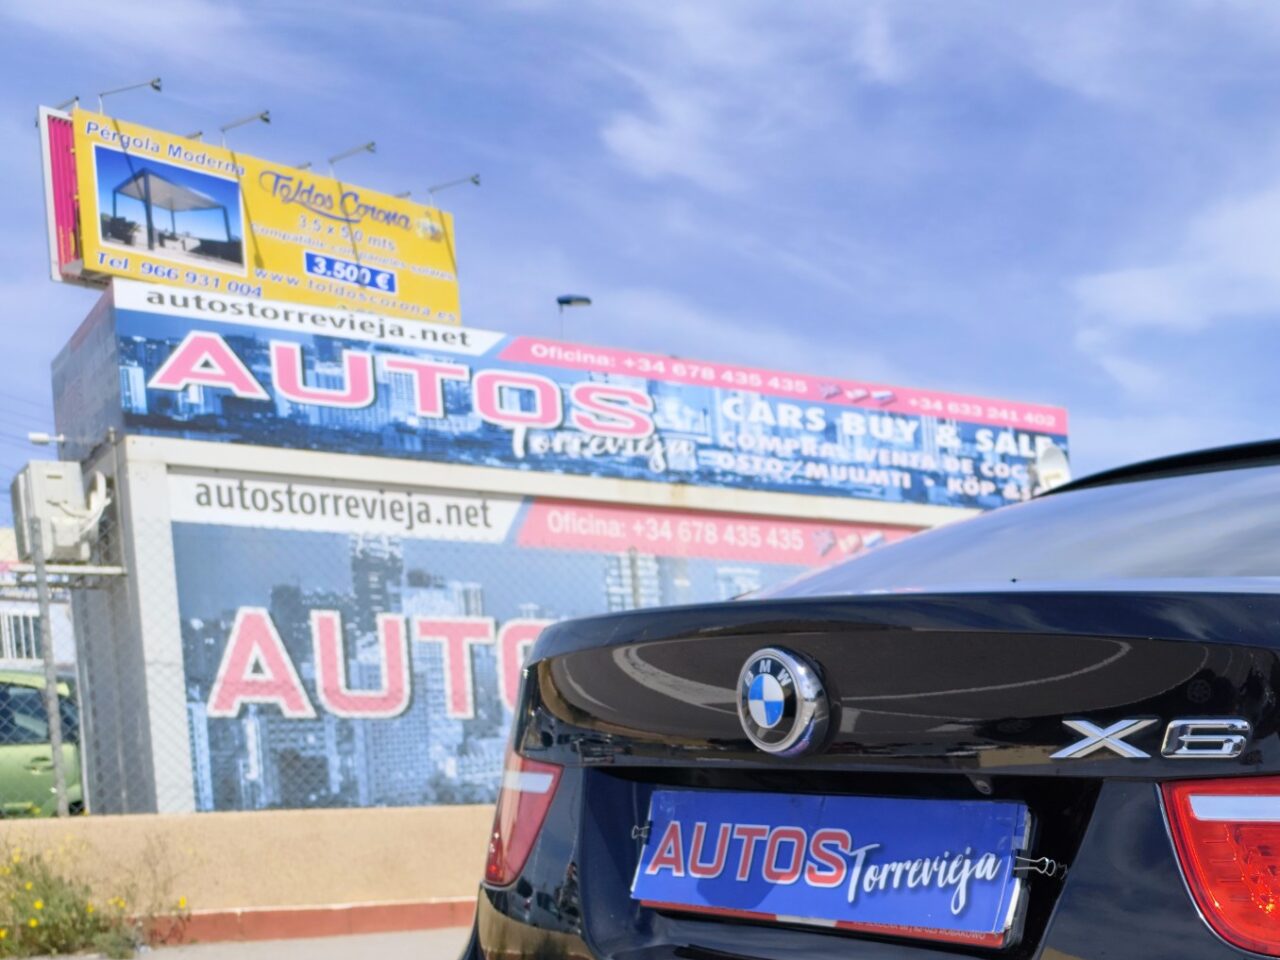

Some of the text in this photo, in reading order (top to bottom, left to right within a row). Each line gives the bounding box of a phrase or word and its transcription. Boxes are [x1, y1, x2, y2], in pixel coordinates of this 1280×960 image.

[86, 120, 245, 177] Pérgola Moderna
[258, 170, 412, 231] Toldos Corona
[141, 261, 179, 281] 966
[185, 270, 220, 289] 931
[227, 280, 263, 298] 004
[312, 255, 391, 291] 3.500 €
[147, 289, 472, 348] autostorrevieja.net
[147, 329, 654, 438] AUTOS
[530, 342, 808, 394] Oficina: +34 678 435 435
[722, 397, 827, 432] CARS
[840, 411, 919, 443] BUY
[935, 423, 961, 449] &
[909, 397, 944, 412] +34
[943, 455, 974, 476] DE
[196, 482, 492, 530] autostorrevieja.net
[547, 510, 804, 550] Oficina: +34 678 435 435
[745, 659, 792, 688] BMW
[1049, 718, 1251, 759] X6
[645, 820, 852, 888] AUTOS
[846, 843, 1001, 915] Torrevieja
